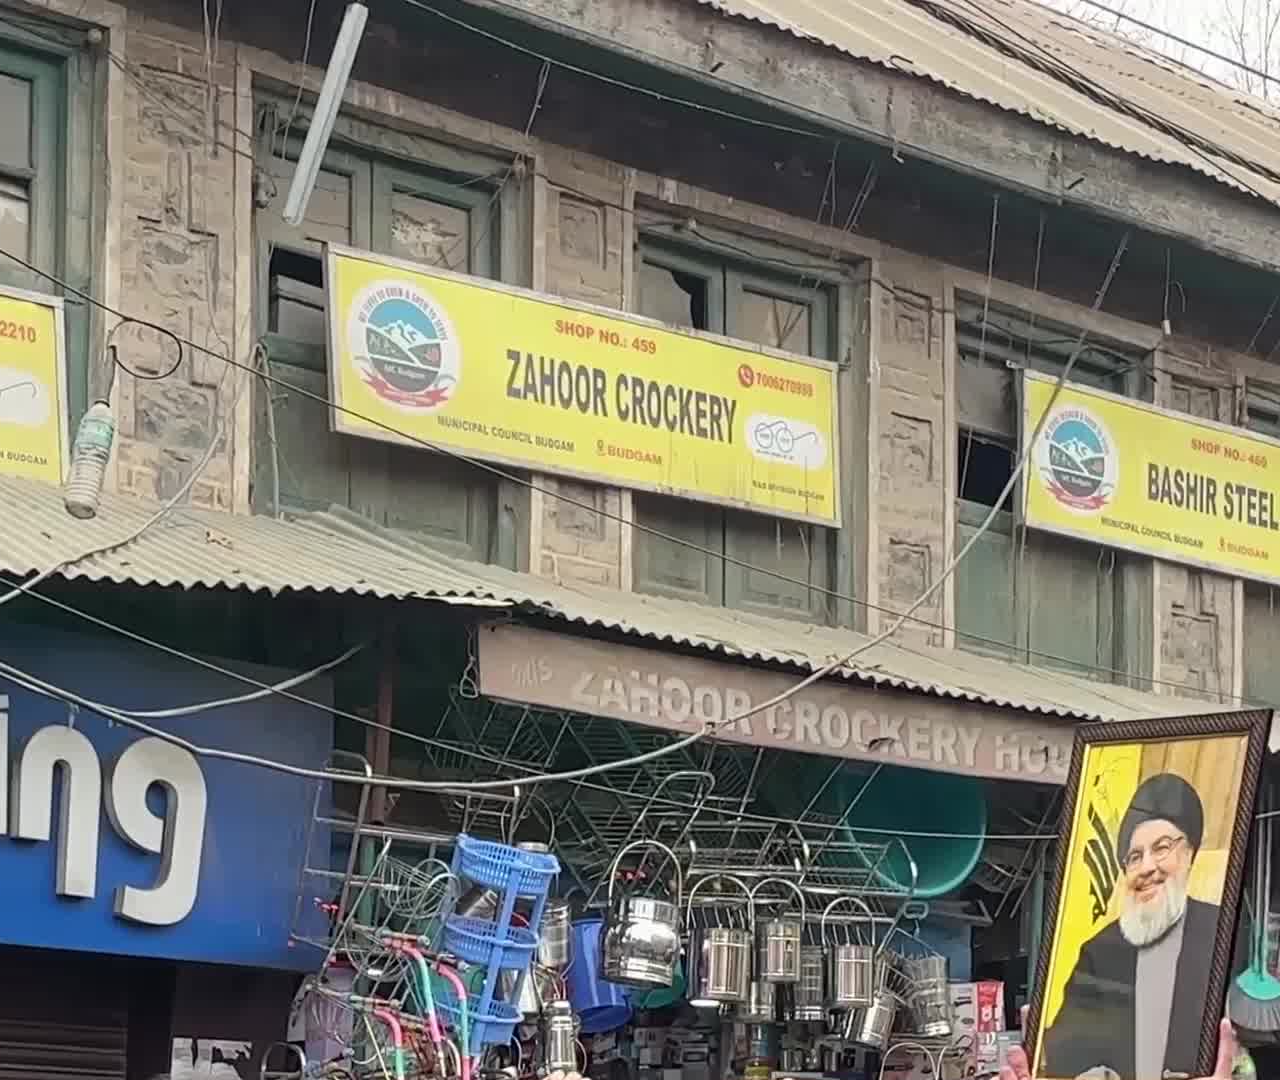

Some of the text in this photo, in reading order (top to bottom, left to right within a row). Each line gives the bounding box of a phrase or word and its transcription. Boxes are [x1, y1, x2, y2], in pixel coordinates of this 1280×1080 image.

[554, 318, 657, 355] SHOP NO.: 459
[506, 348, 737, 445] ZAHOOR CROCKERY
[437, 415, 575, 452] MUNICIPAL COUNCIL BUDGAM
[1191, 438, 1221, 455] SHOP
[7, 451, 48, 465] BUDGAM
[607, 445, 662, 466] BUDGAM
[1148, 462, 1217, 516] BASHIR
[1224, 482, 1279, 530] STEEL
[573, 667, 756, 733] ZAHOOR
[767, 698, 981, 768] CROCKERY
